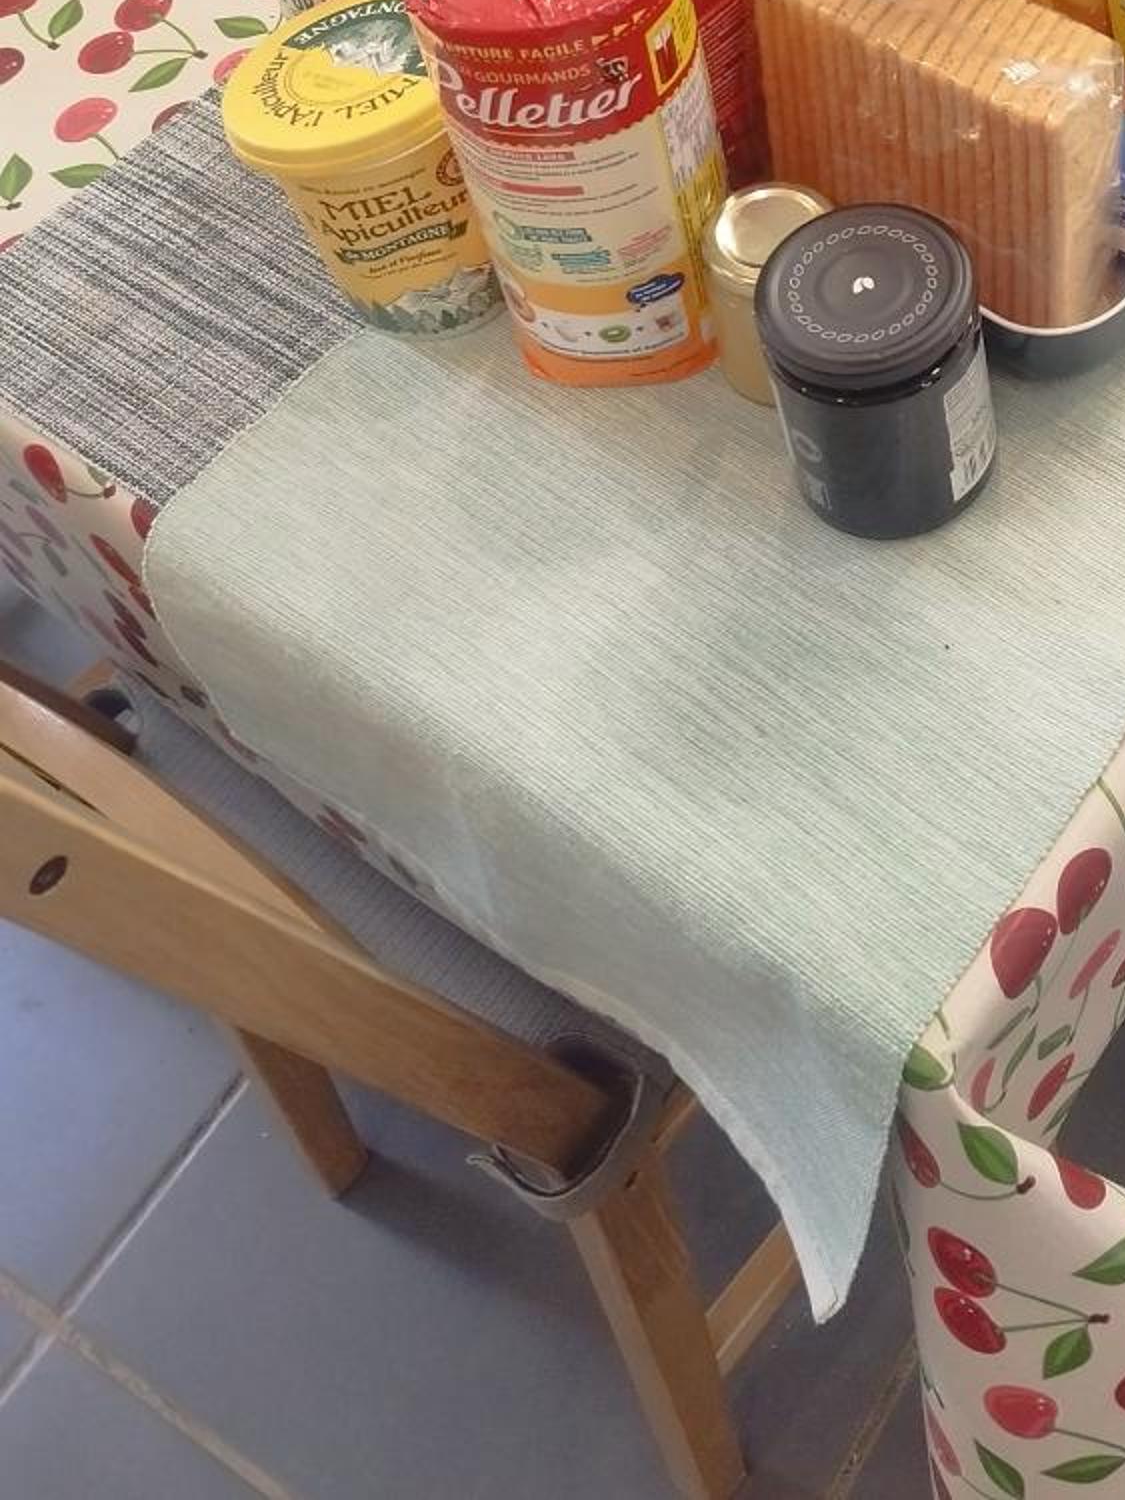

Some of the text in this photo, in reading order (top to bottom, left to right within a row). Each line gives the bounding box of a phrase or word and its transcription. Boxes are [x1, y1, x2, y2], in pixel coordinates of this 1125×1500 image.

[292, 0, 409, 45] ONTAGNE
[521, 39, 585, 60] FACILE
[475, 64, 592, 85] GOURMANDS
[334, 76, 420, 120] MIEL
[319, 186, 432, 221] MIEL
[360, 224, 451, 261] MONTAGNE
